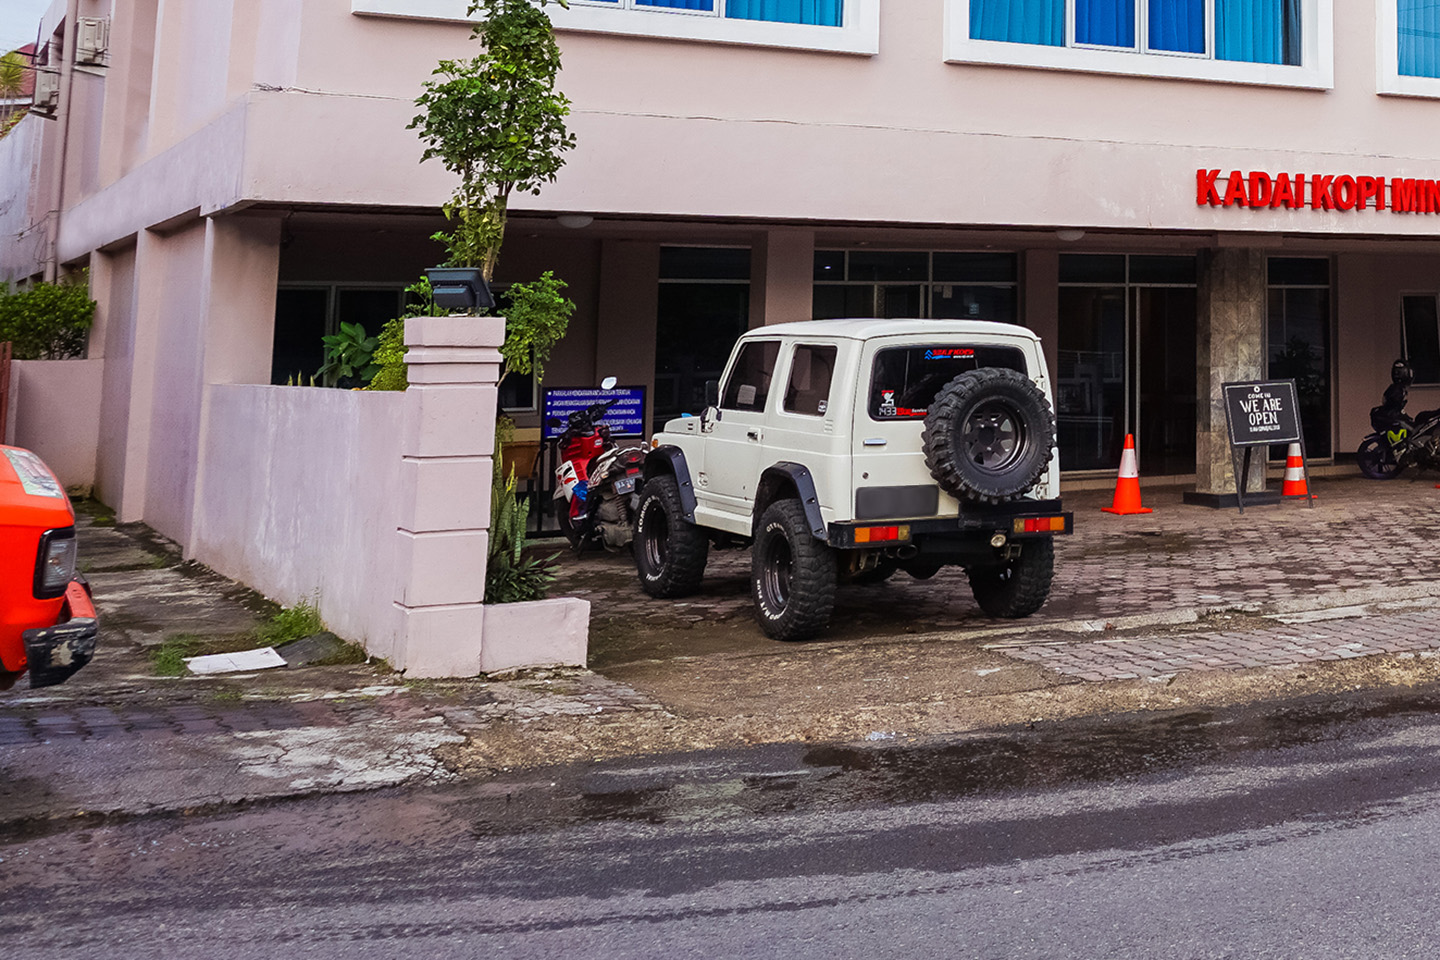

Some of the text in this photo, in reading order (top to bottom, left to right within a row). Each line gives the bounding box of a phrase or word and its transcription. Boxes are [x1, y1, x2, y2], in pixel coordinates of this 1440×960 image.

[1196, 168, 1305, 208] KADAI
[1311, 174, 1386, 212] KOPI
[1239, 397, 1283, 413] WE ARE
[1249, 411, 1278, 425] OPEN
